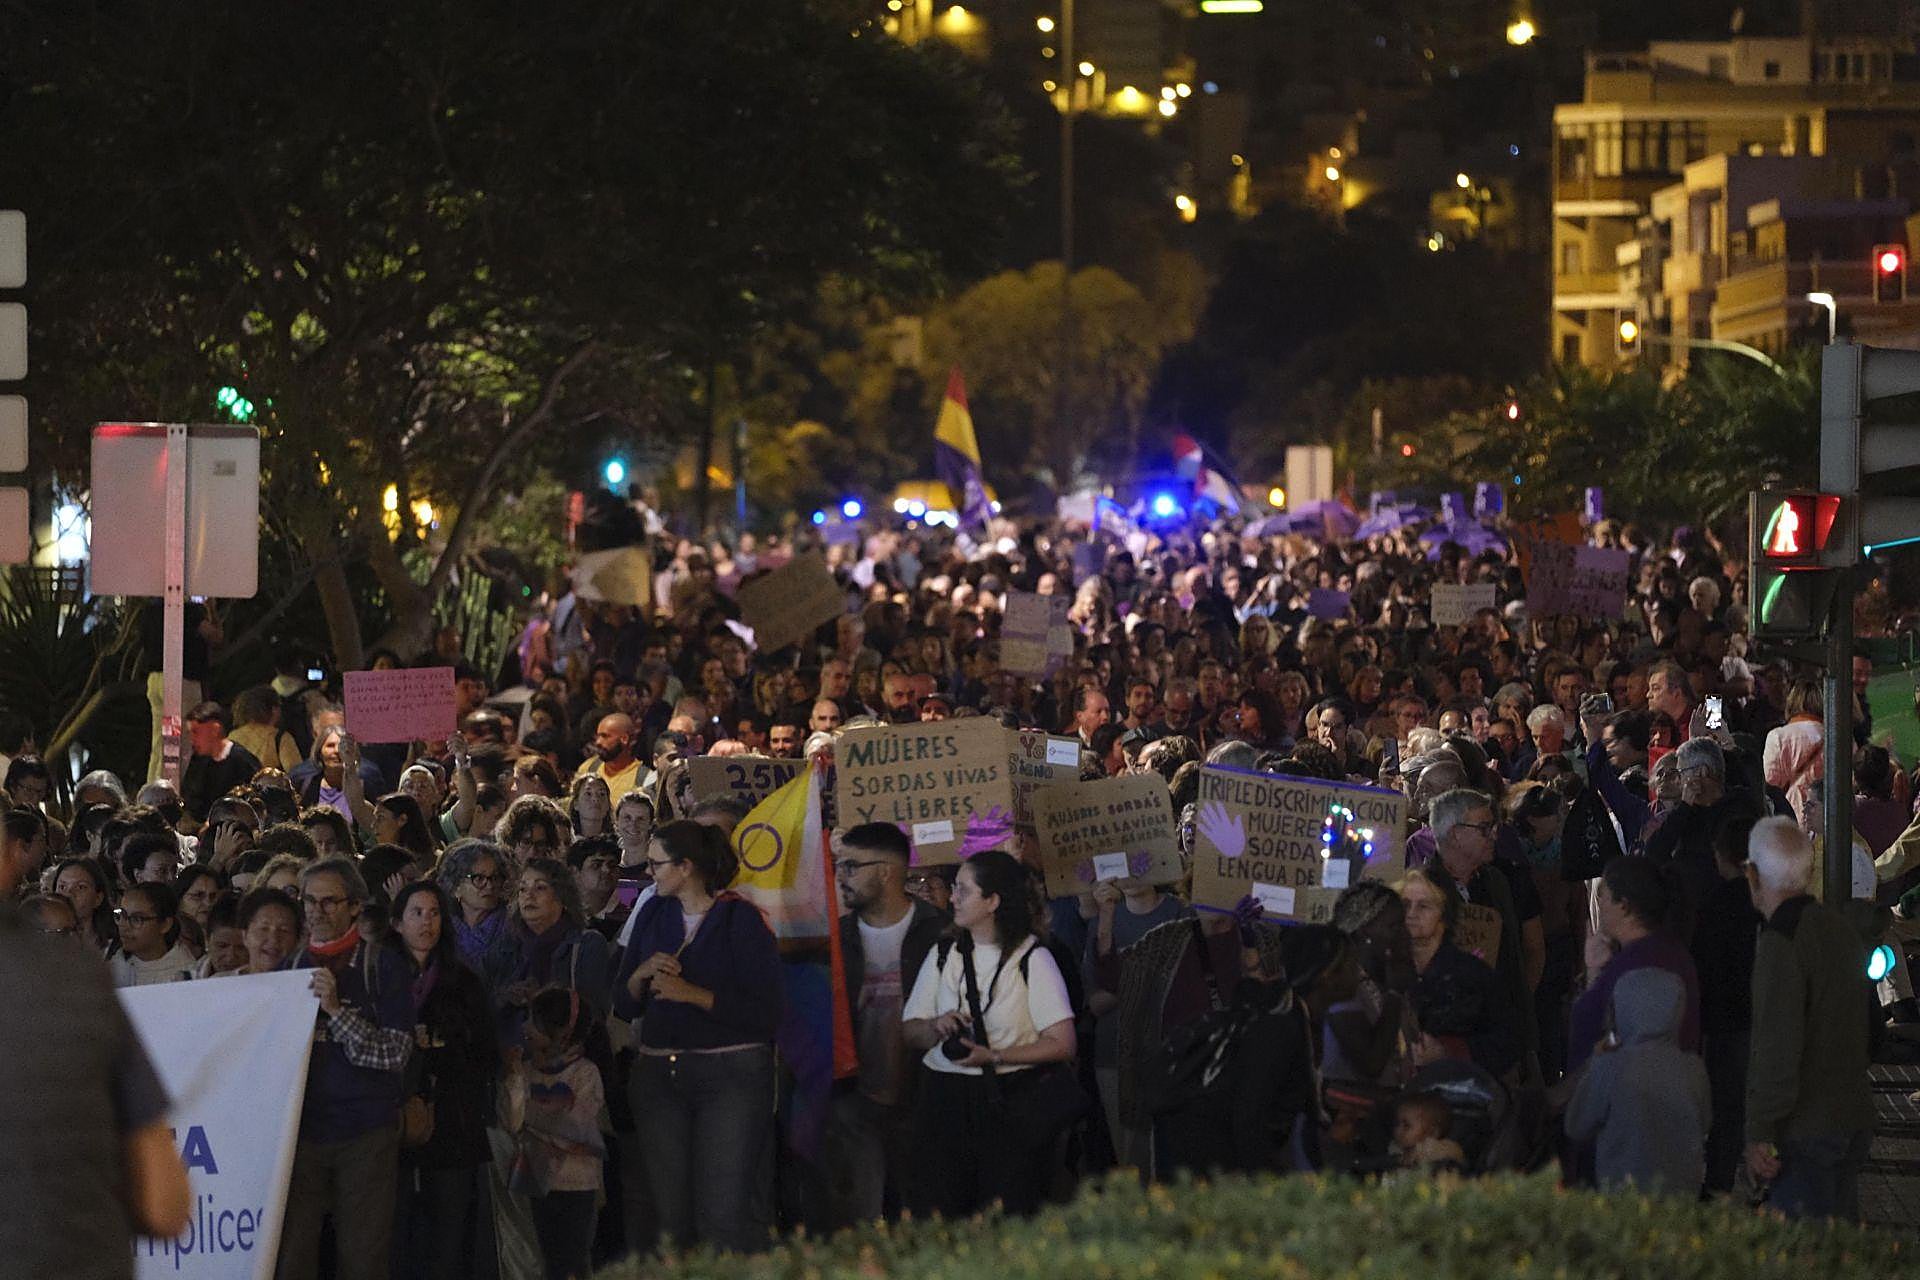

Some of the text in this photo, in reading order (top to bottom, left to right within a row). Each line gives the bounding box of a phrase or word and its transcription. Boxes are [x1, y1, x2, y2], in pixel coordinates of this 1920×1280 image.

[726, 763, 796, 790] 25N
[851, 771, 938, 798] SORDAS
[1201, 772, 1252, 808] TRIPLE
[856, 796, 975, 824] Y LIBRES
[1107, 795, 1163, 815] SORDAS
[1051, 824, 1109, 846] CONTRA
[1248, 810, 1325, 841] MUJERE
[1248, 836, 1324, 866] SORDA
[1217, 855, 1316, 887] LENGUA DE
